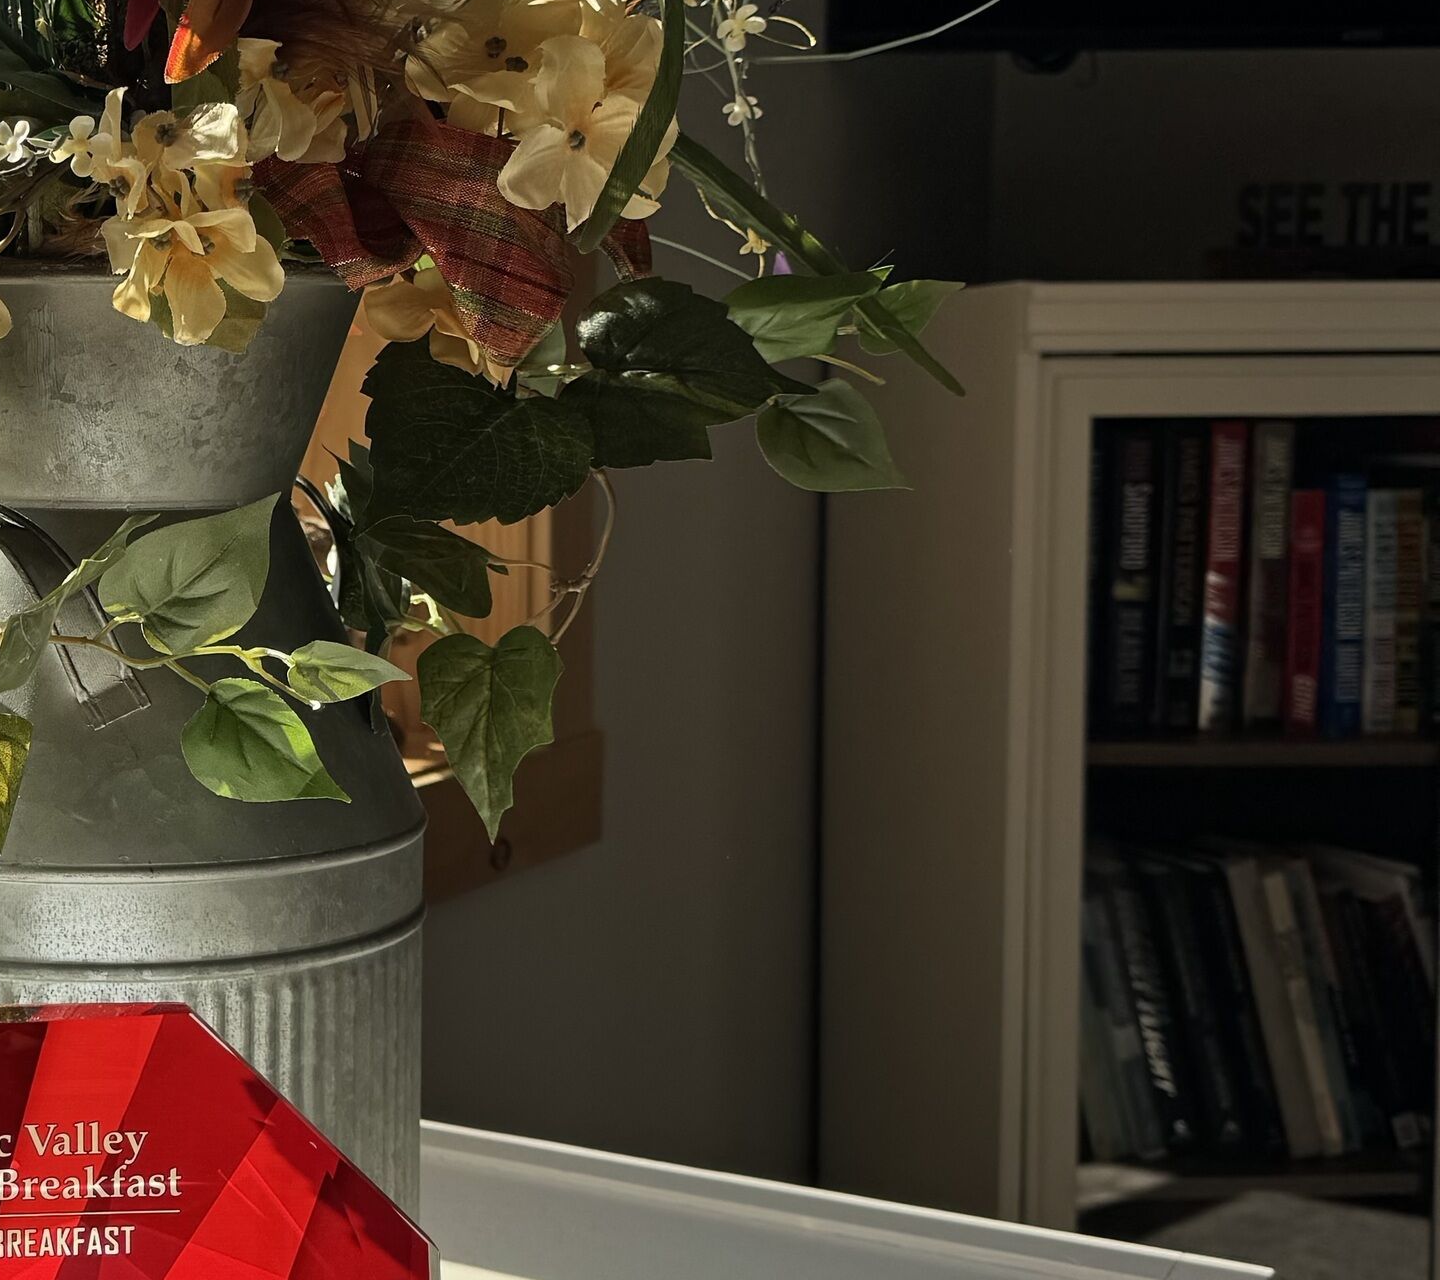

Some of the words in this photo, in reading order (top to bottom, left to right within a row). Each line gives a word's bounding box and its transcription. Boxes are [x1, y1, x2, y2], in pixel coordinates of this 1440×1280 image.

[1237, 182, 1325, 246] SEE
[1341, 182, 1432, 246] THE
[24, 1121, 149, 1165] Valley
